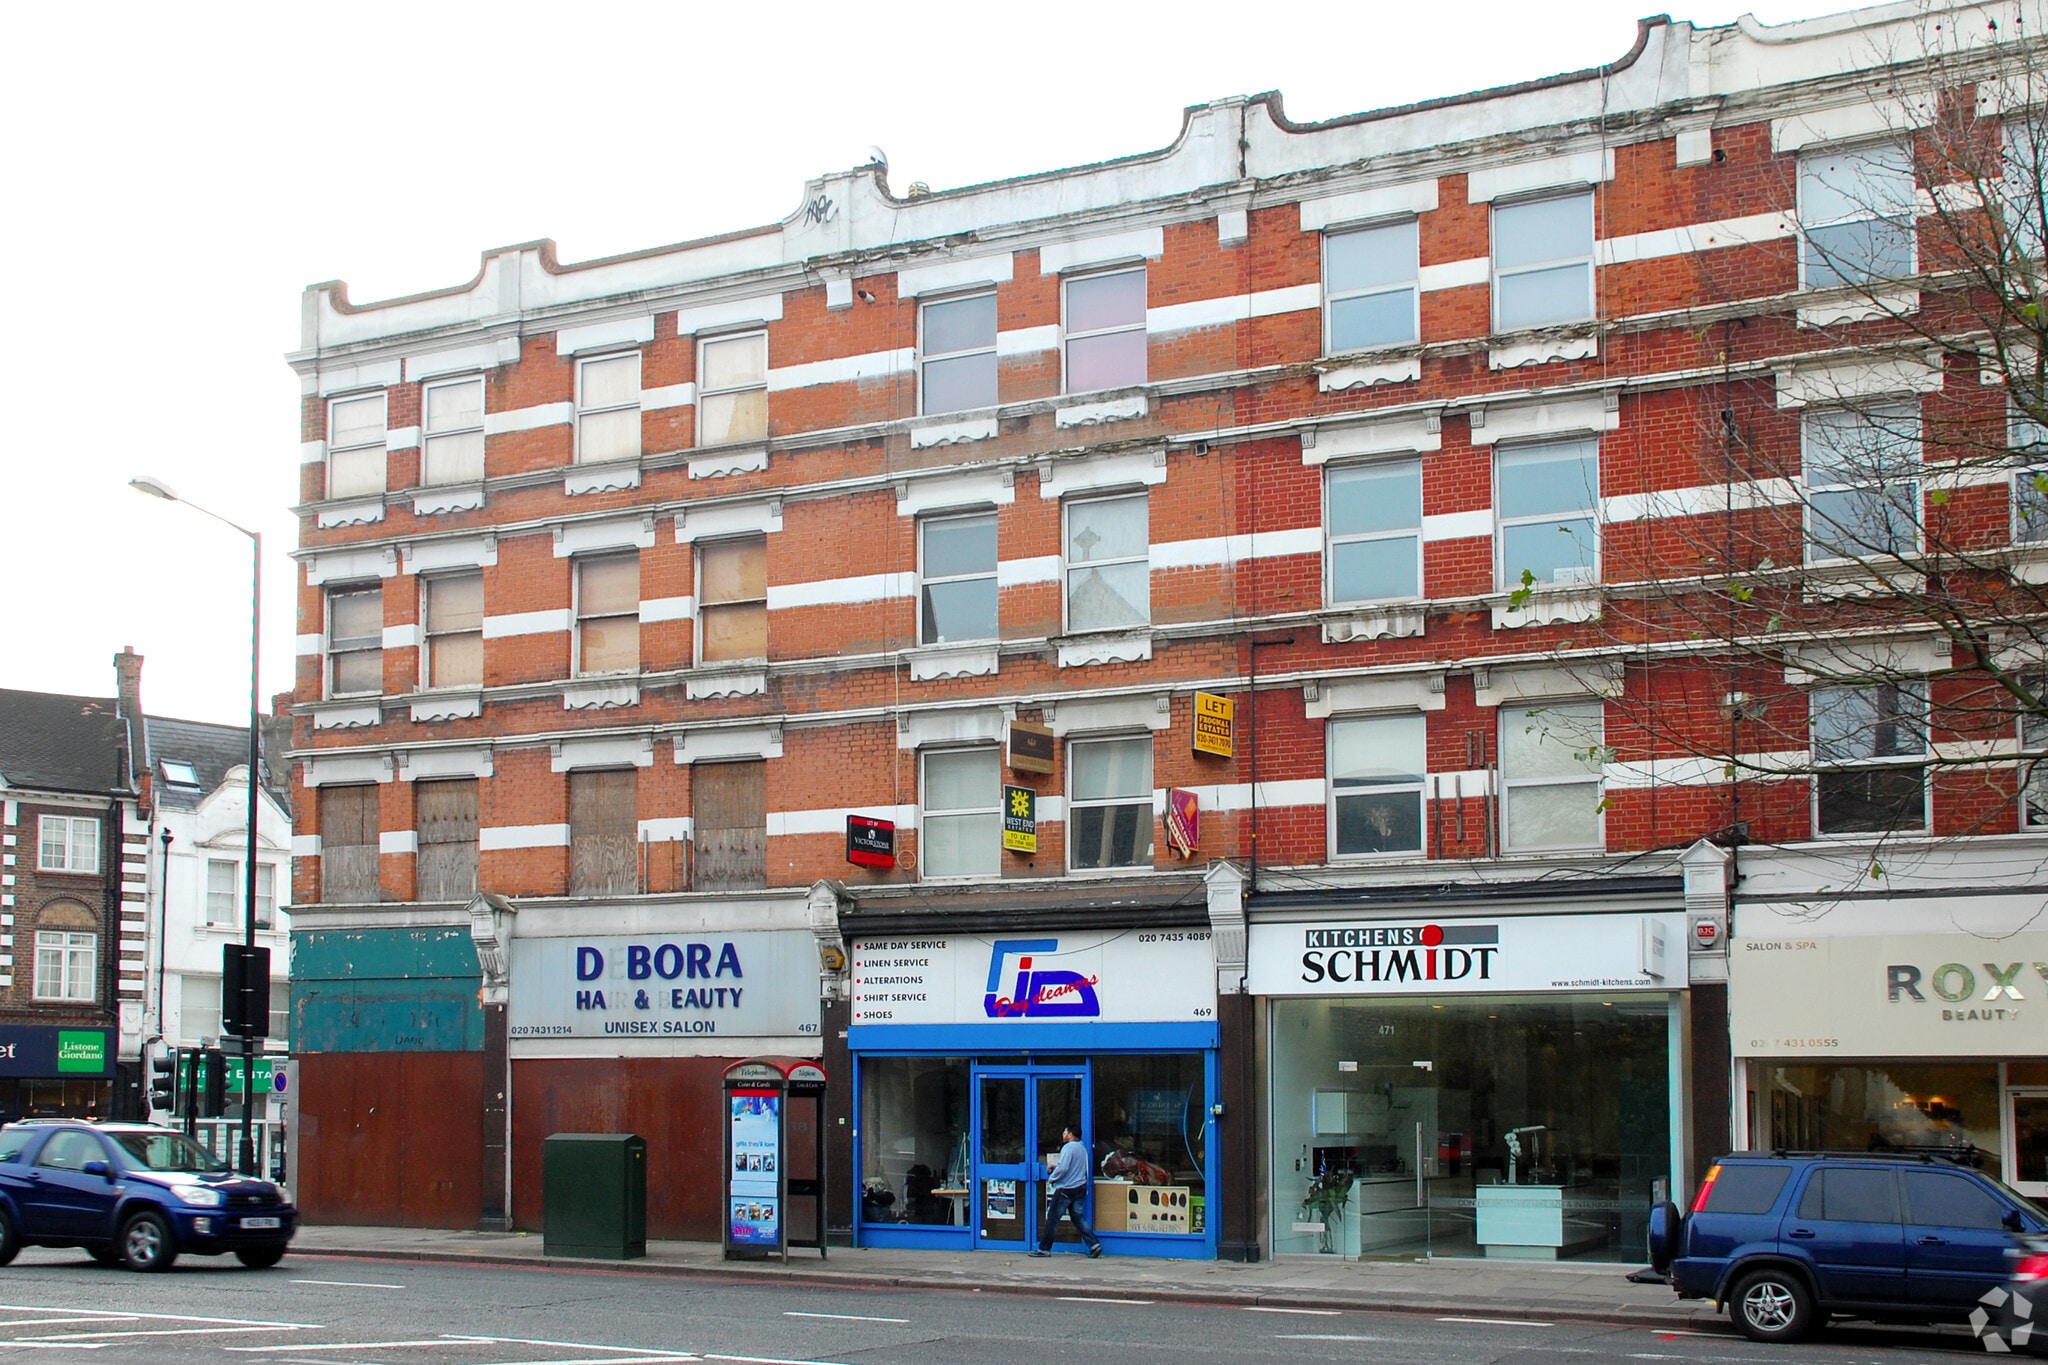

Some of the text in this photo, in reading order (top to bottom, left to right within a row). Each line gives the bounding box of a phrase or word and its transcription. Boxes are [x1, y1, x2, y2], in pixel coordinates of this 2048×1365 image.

[1205, 699, 1226, 714] LET
[1199, 722, 1230, 736] ESTATES
[1138, 932, 1212, 943] 020 7435 4089
[1308, 929, 1414, 947] KITCHENS
[863, 940, 947, 951] SAME DAY SERVICE
[1746, 943, 1781, 951] SALON
[1796, 941, 1817, 950] SPA
[863, 958, 929, 968] LINEN SERVICE
[1301, 946, 1499, 984] SCHMIDT
[863, 976, 924, 985] ALTERATIONS
[1551, 979, 1651, 987] www.schmidt-kitchens.com
[634, 989, 650, 1009] &
[863, 993, 927, 1002] SHIRT SERVICE
[863, 1011, 893, 1019] SHOES
[1192, 1007, 1212, 1016] 469
[1942, 1008, 2019, 1021] BEAUTY
[604, 1020, 716, 1034] UNISEX SALON
[798, 1024, 818, 1032] 467
[1379, 1025, 1395, 1035] 471
[64, 1041, 99, 1050] Listone
[59, 1050, 102, 1059] Giordano
